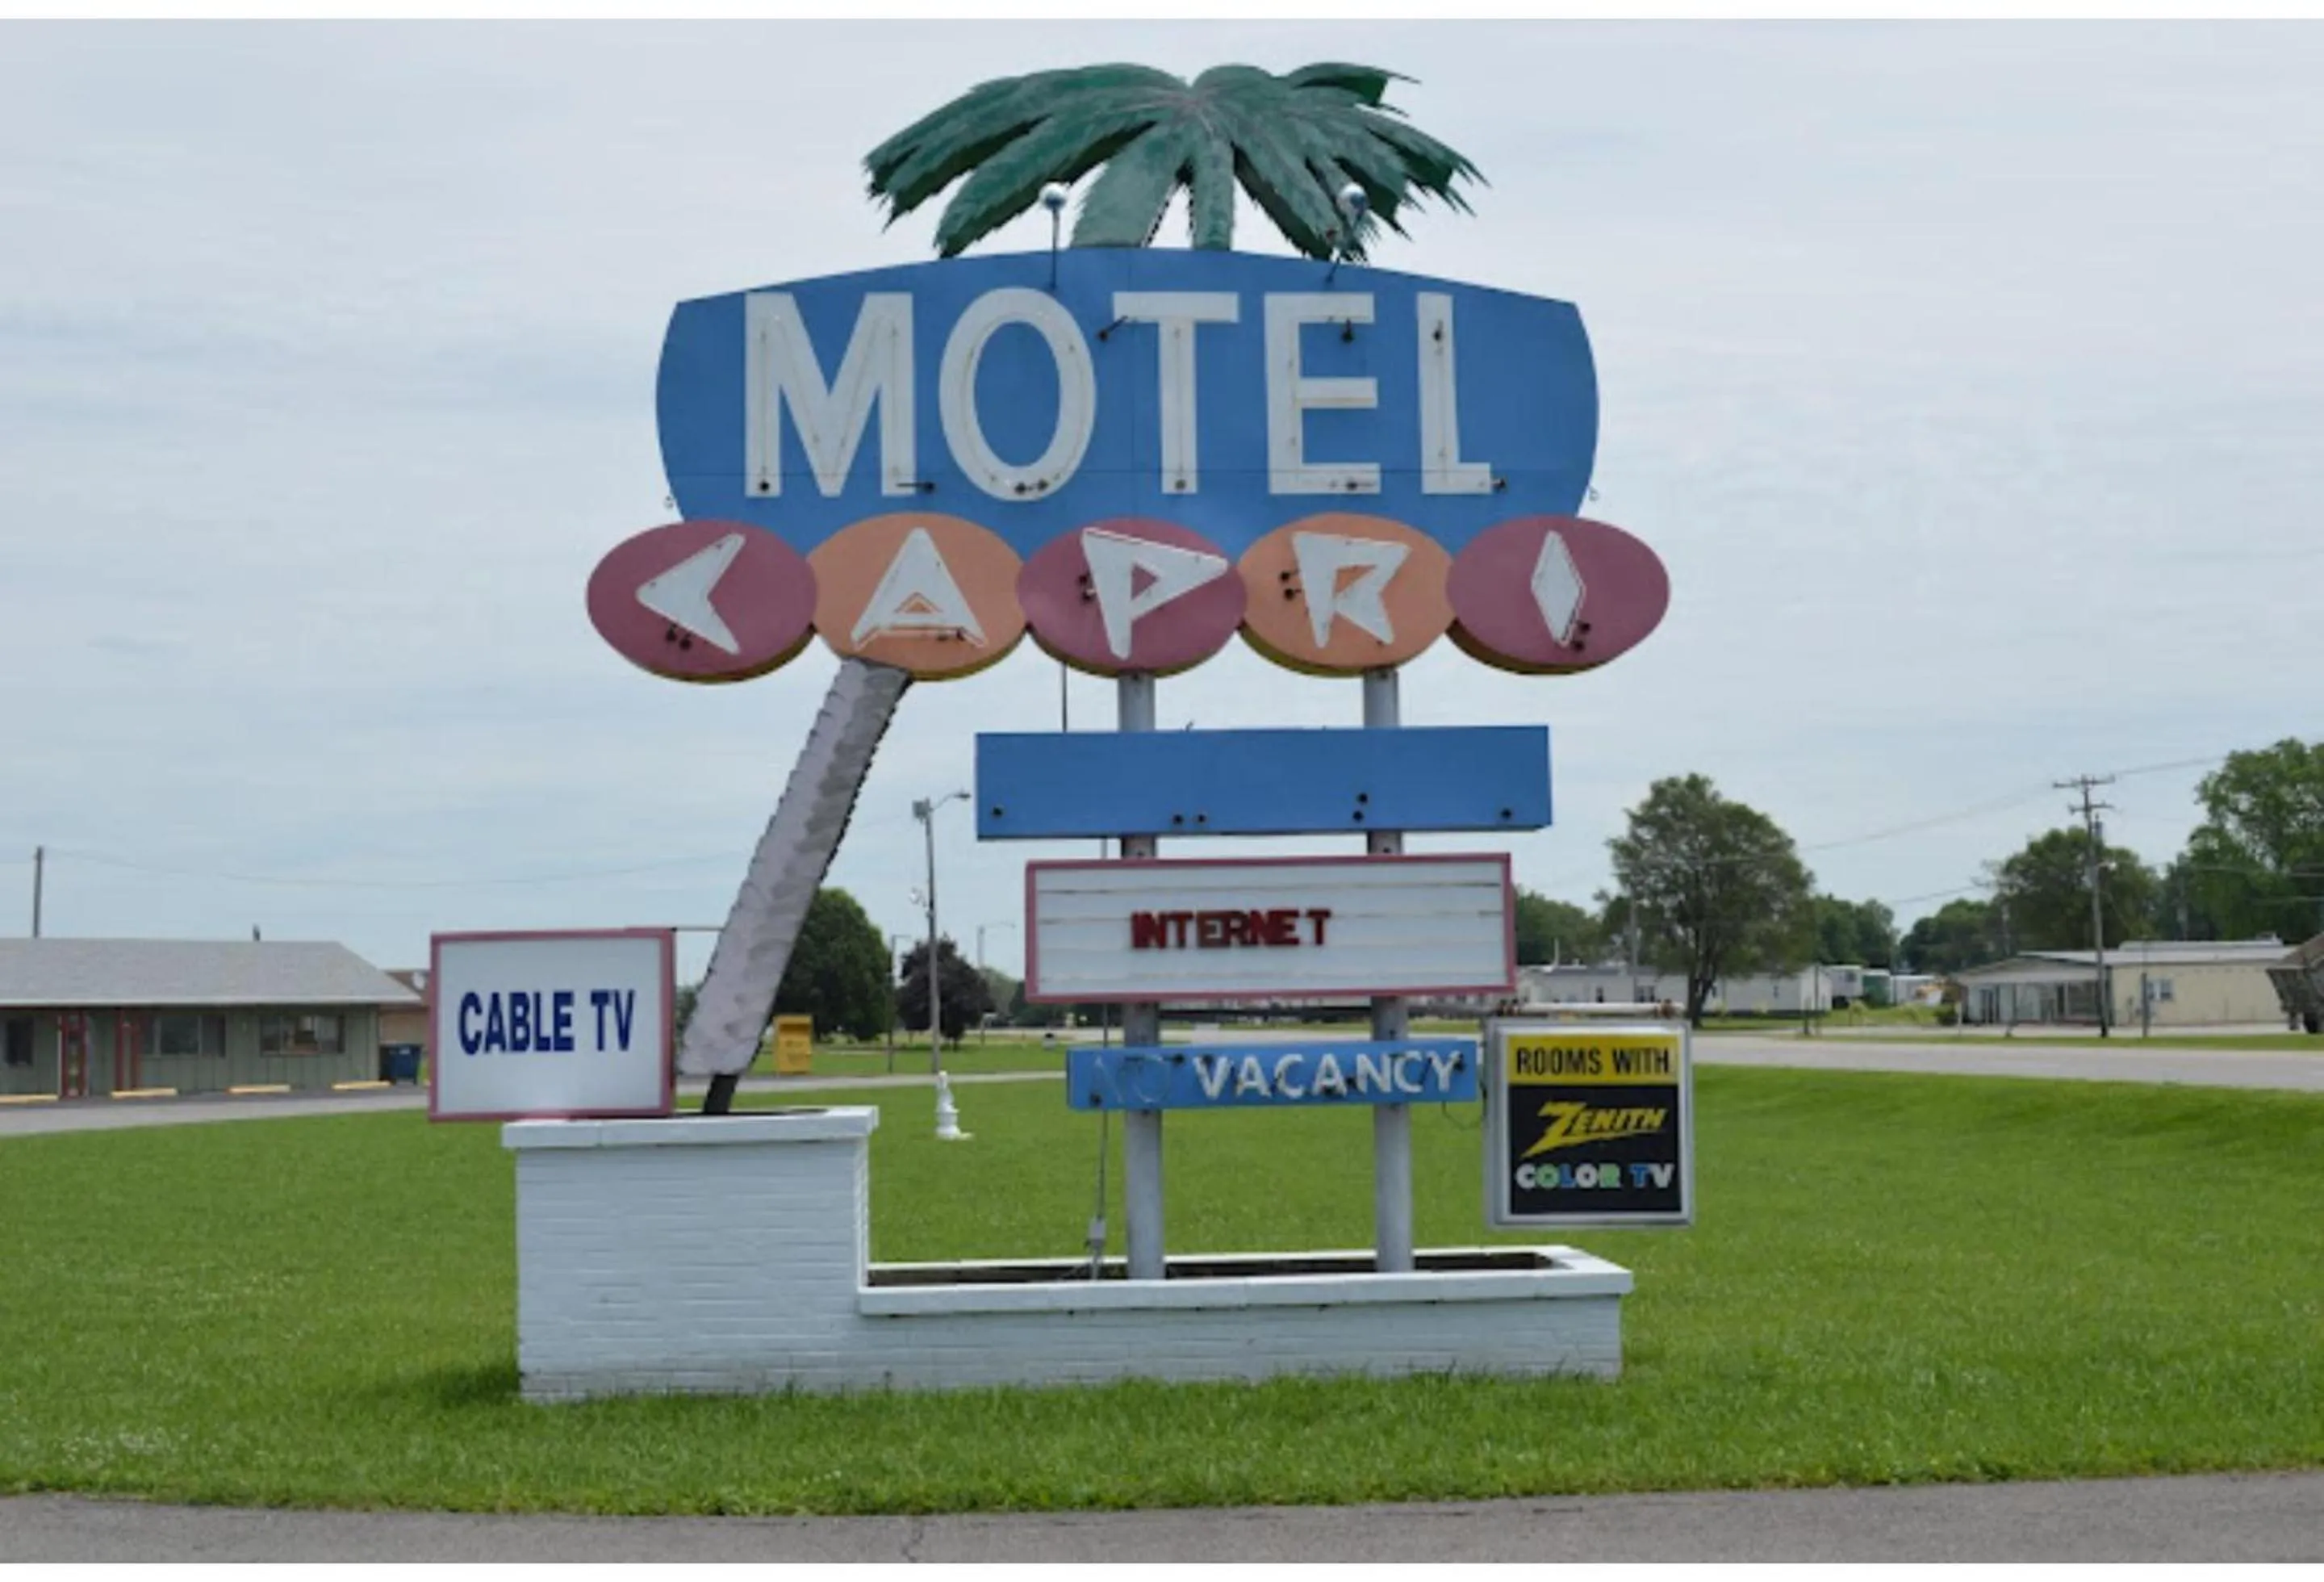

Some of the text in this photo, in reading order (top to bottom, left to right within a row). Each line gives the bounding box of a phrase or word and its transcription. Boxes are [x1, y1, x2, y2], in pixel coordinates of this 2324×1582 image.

[744, 287, 1492, 501] MOTEL
[635, 527, 1587, 658] CAPRI
[1131, 909, 1332, 949] INTERNET
[458, 989, 635, 1055] CABLE TV
[1193, 1050, 1461, 1099] VACANCY
[1516, 1048, 1670, 1075] ROOMS WITH
[1521, 1101, 1668, 1159] ZENITH
[1515, 1163, 1674, 1191] COLOR TV
